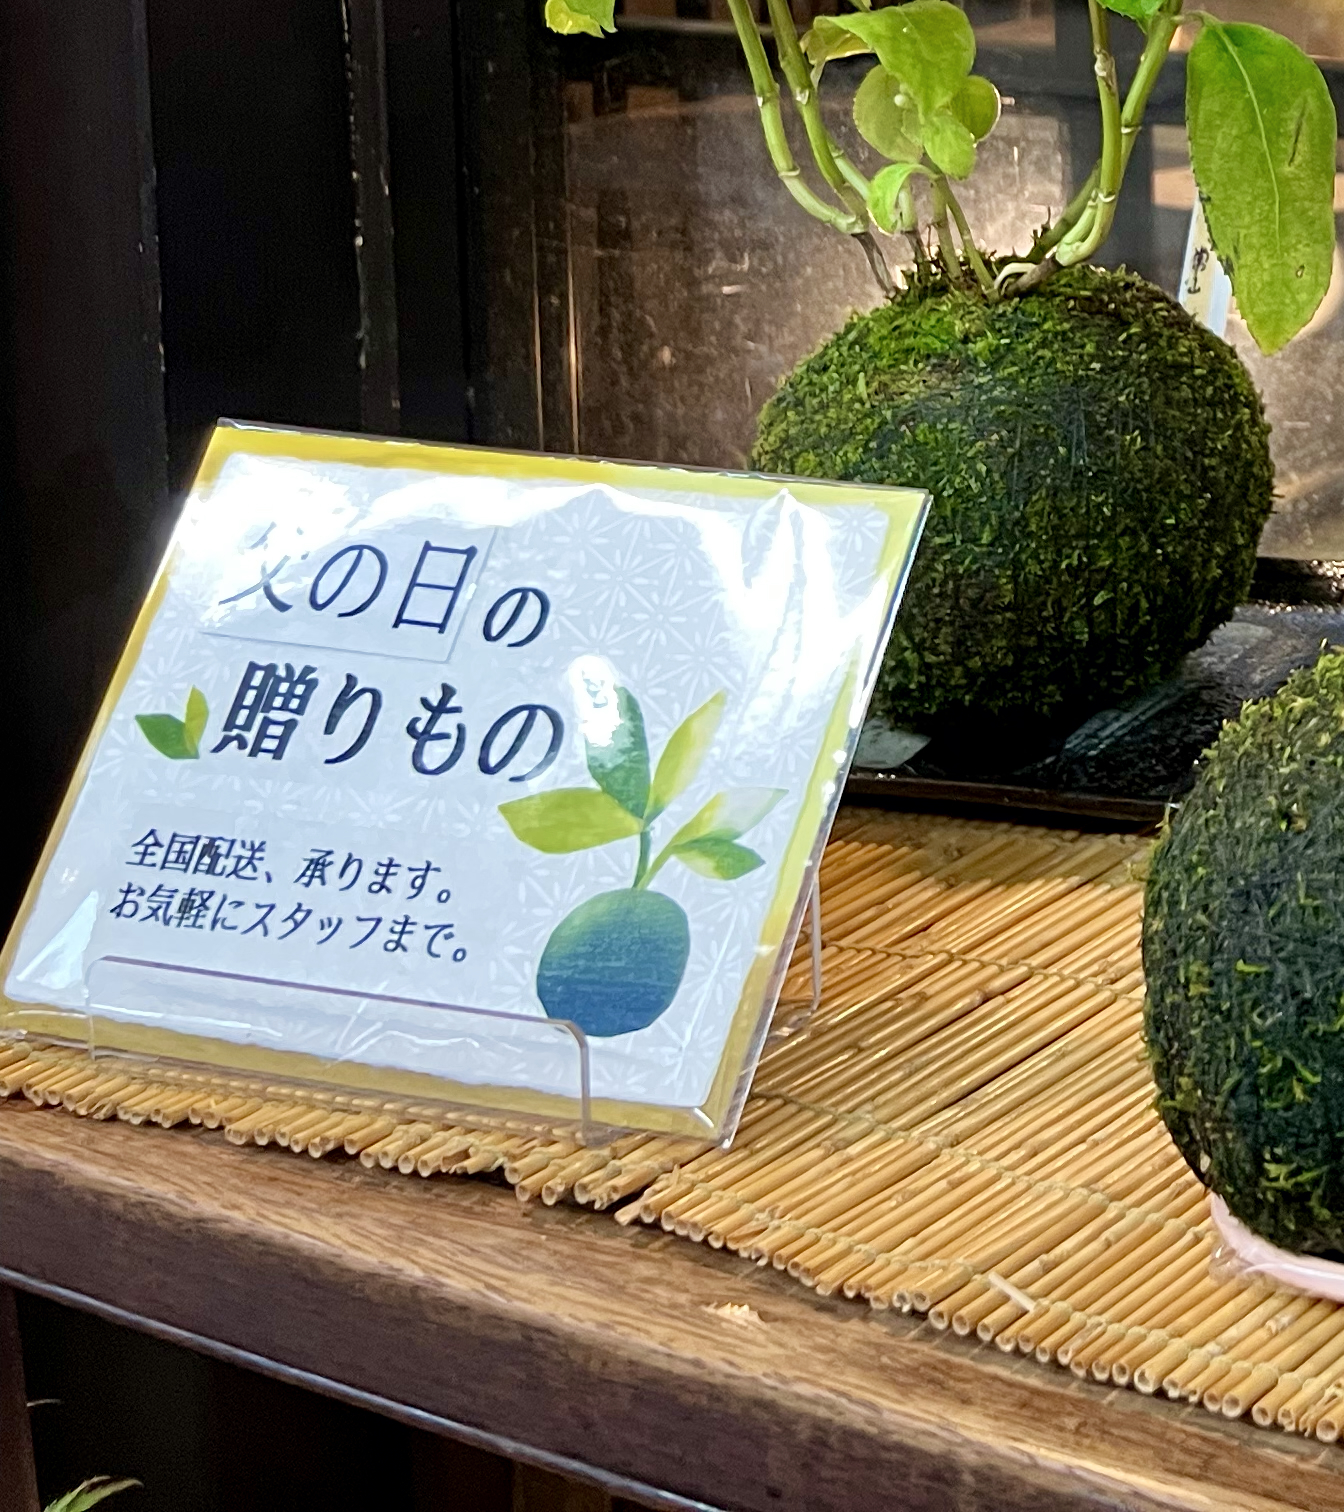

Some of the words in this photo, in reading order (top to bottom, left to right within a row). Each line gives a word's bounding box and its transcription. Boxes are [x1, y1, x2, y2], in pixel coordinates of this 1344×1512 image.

[210, 660, 565, 783] 贈りもの
[125, 828, 452, 904] 全国配送、承ります。
[109, 882, 468, 963] お気軽にスタッフまで。
